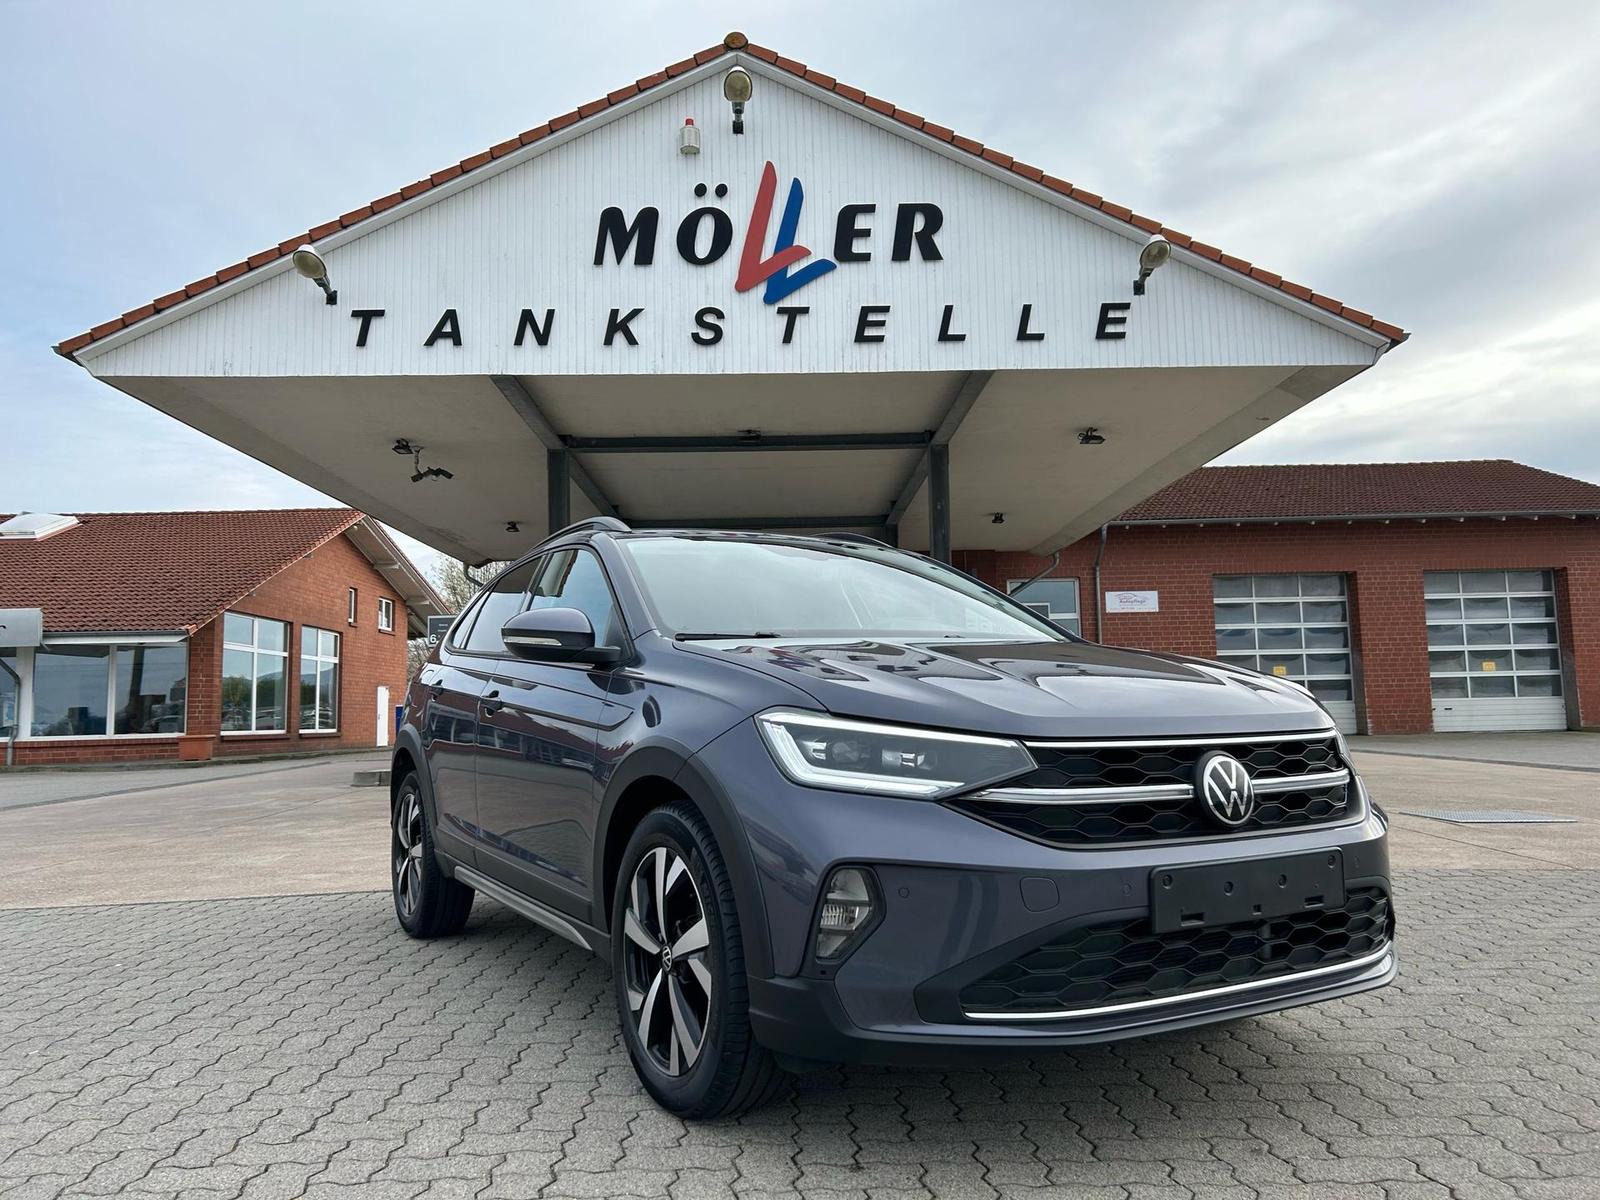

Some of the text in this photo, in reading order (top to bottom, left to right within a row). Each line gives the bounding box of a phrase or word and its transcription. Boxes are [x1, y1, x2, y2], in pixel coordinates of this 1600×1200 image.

[594, 161, 943, 305] MÖLLER
[351, 303, 1131, 347] TANKSTELLE
[1205, 757, 1252, 822] VW
